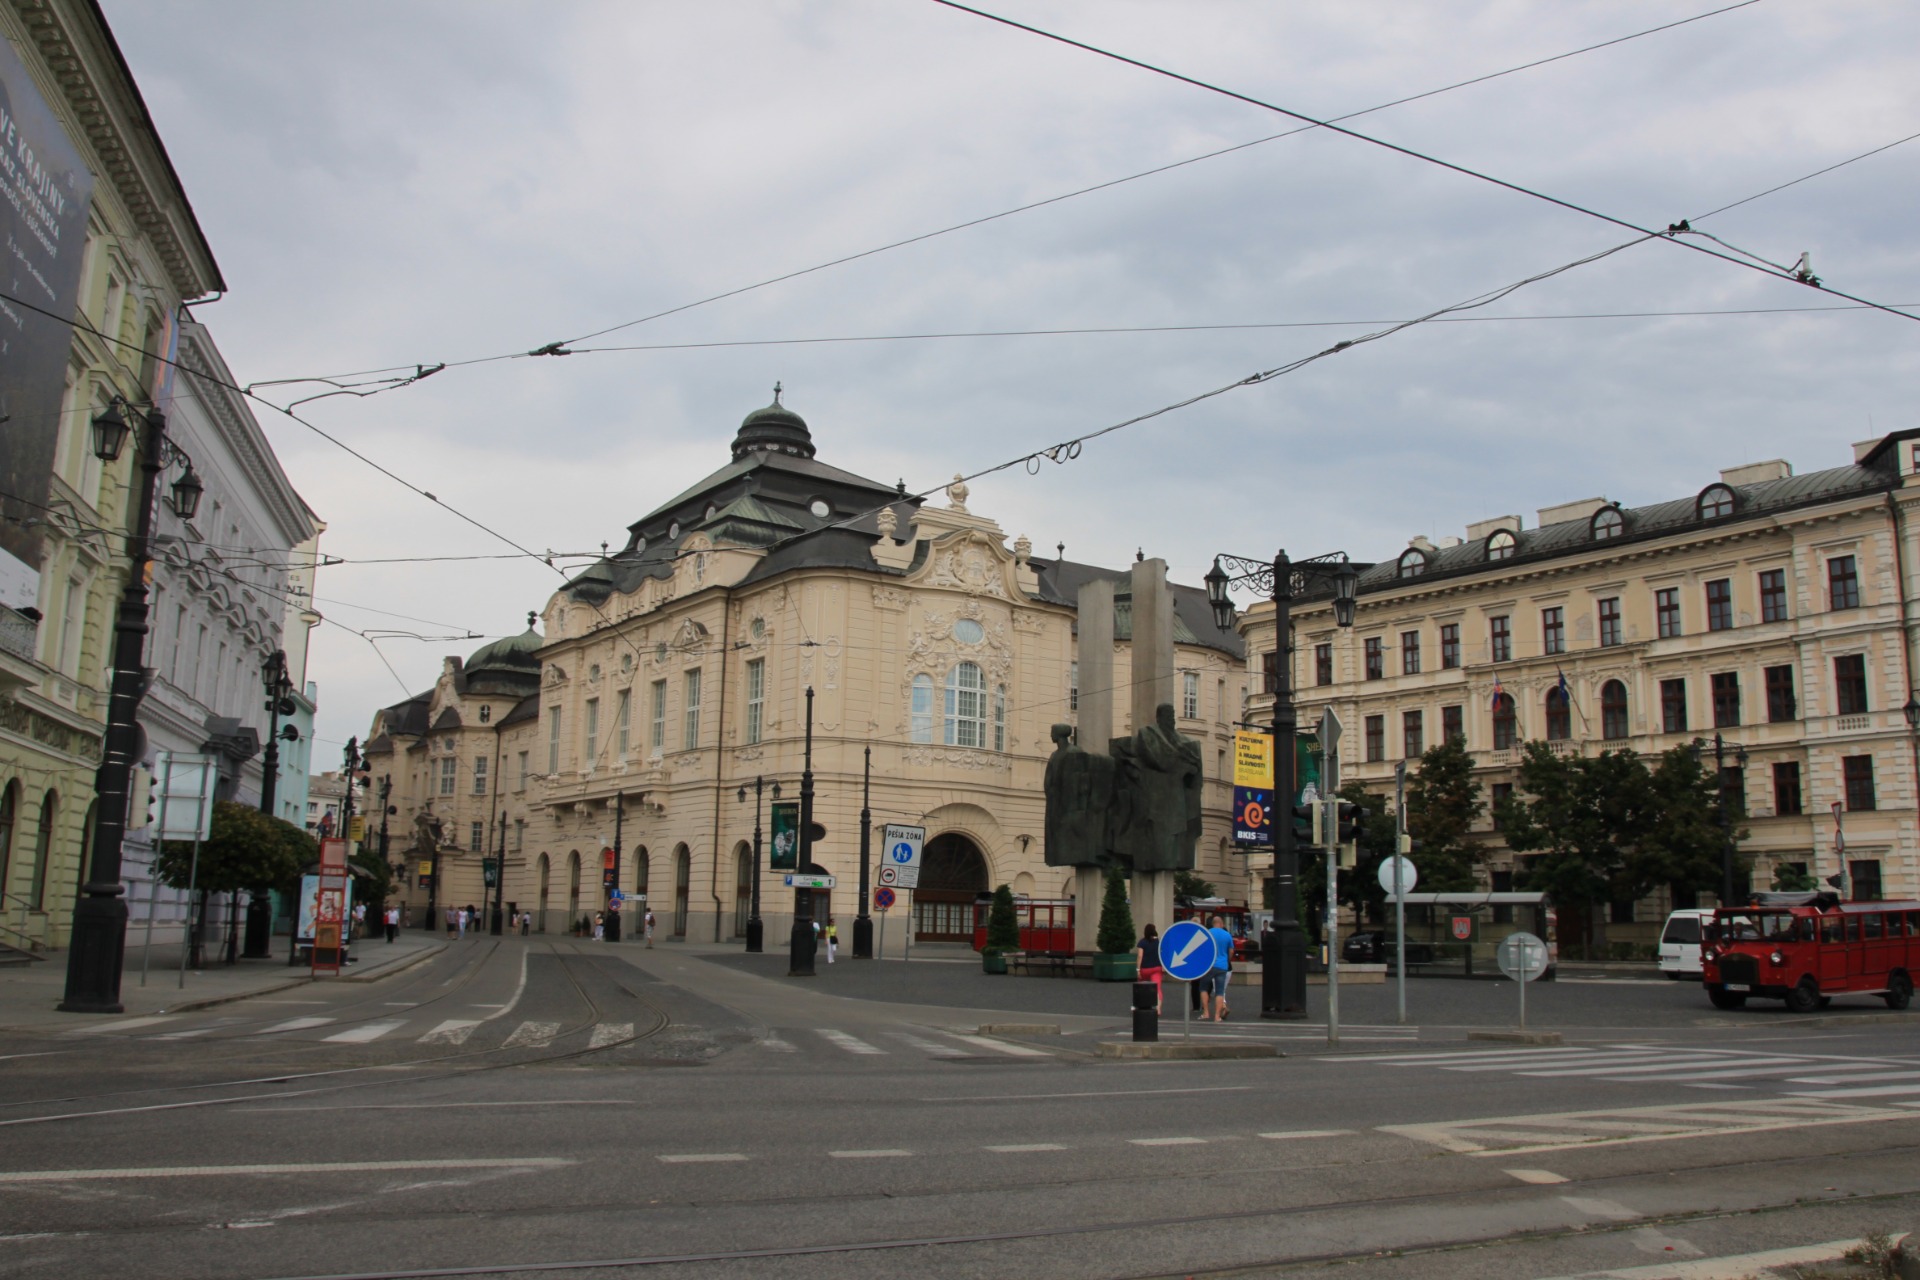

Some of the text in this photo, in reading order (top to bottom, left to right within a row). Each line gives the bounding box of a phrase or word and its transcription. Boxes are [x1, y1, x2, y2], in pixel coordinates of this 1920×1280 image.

[17, 136, 65, 216] KRAJINY
[16, 172, 59, 241] SLOVENSKA
[887, 829, 922, 841] PEŠIA ZÓNA
[1237, 831, 1257, 840] BKIS
